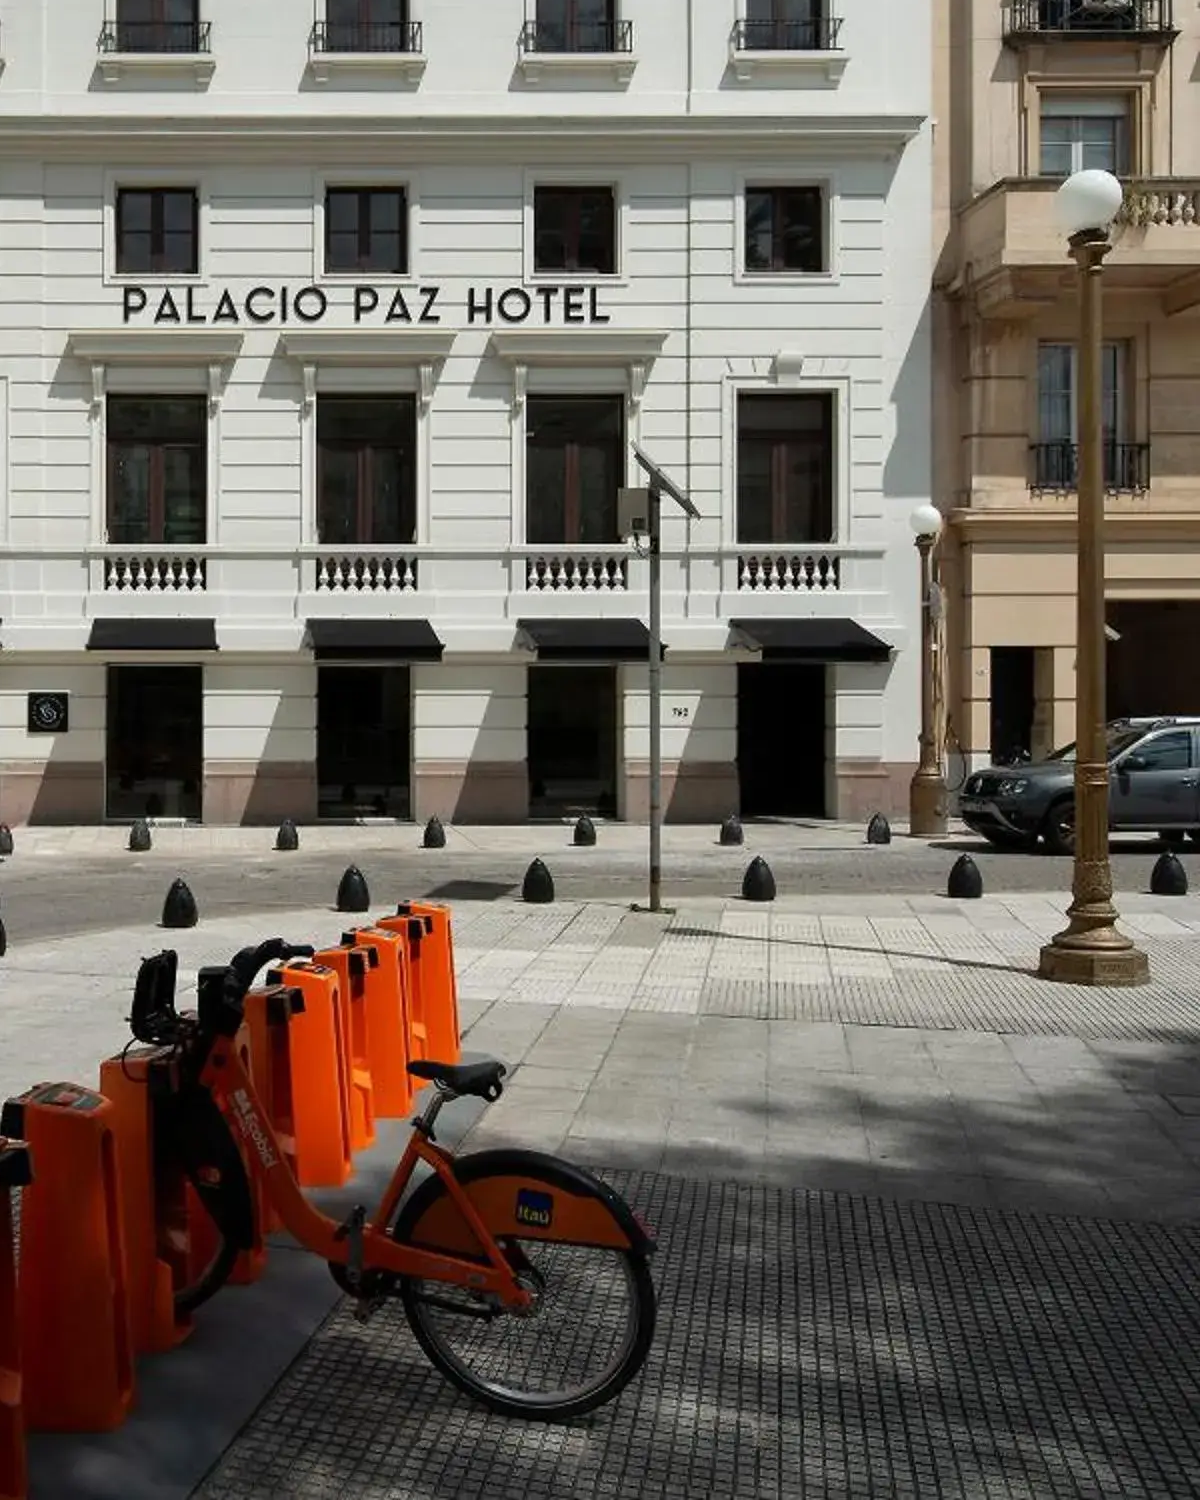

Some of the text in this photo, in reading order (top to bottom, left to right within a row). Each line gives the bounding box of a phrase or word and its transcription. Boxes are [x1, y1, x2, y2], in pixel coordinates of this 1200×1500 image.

[122, 285, 612, 324] PALACIO PAZ HOTEL
